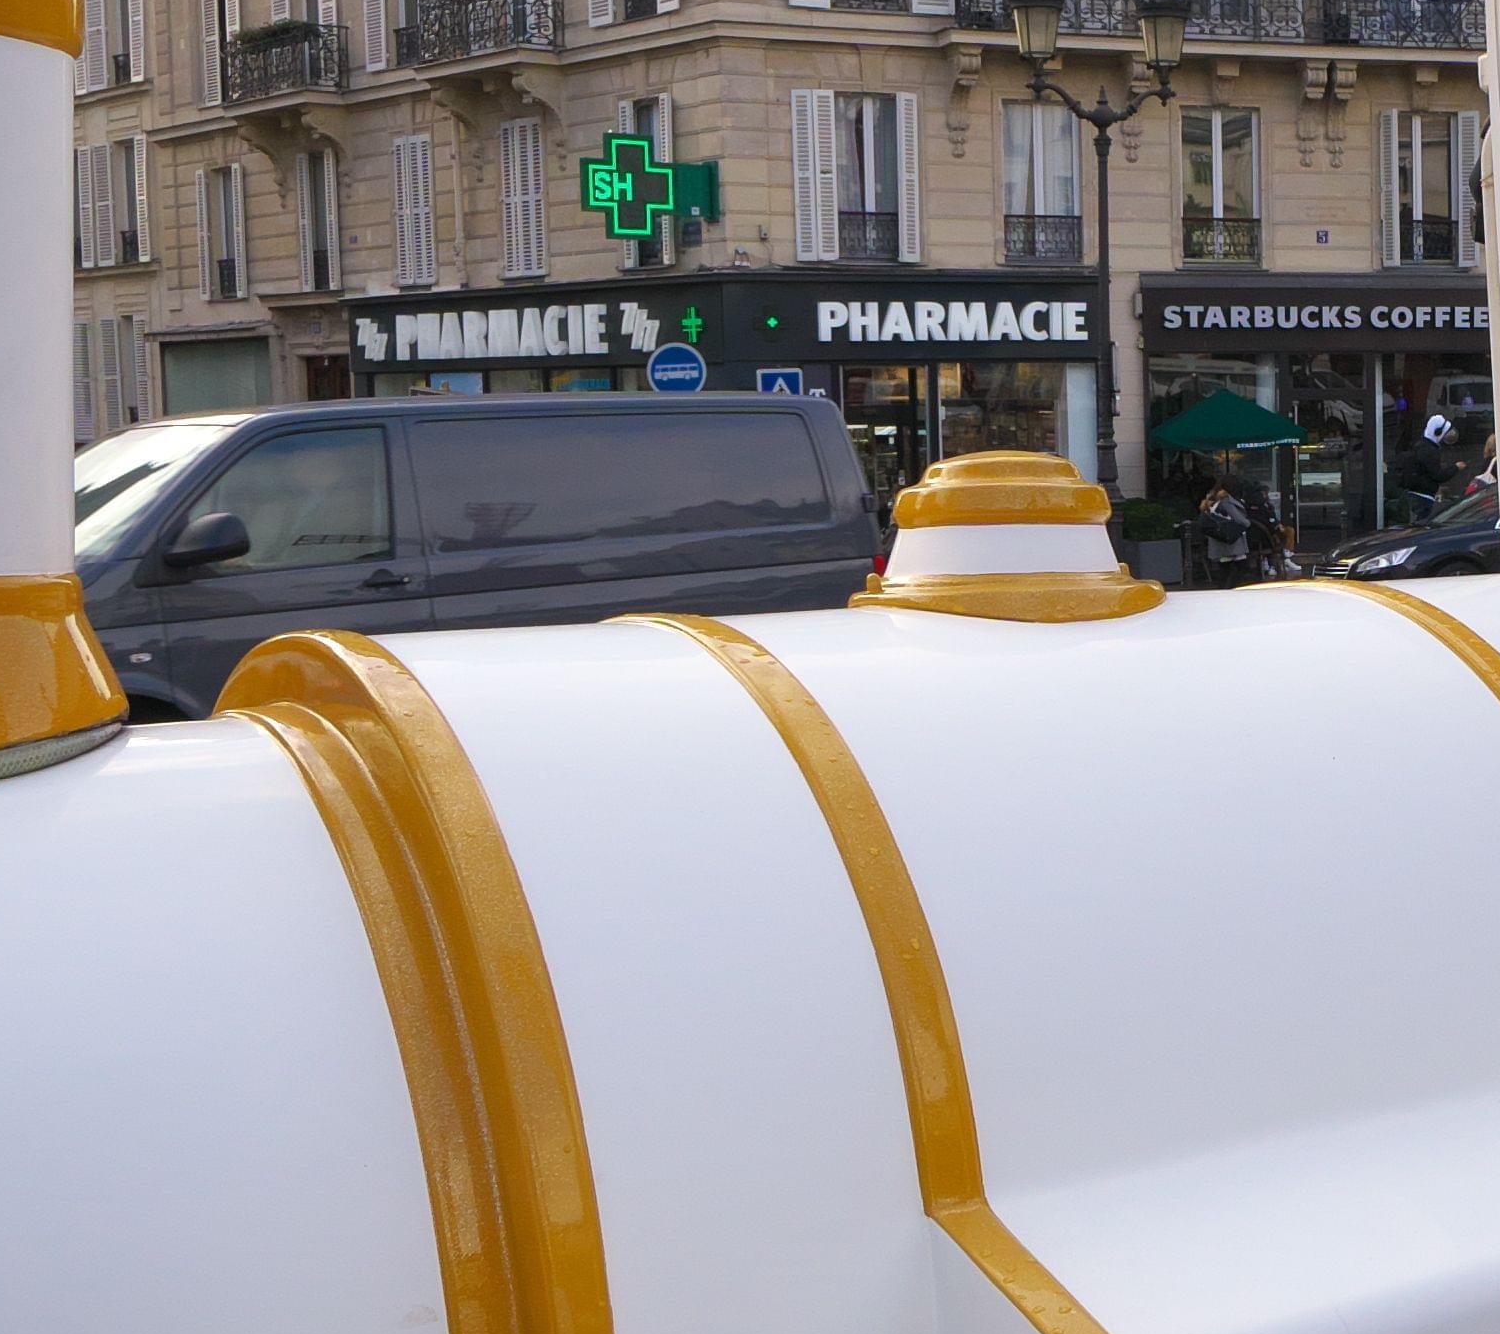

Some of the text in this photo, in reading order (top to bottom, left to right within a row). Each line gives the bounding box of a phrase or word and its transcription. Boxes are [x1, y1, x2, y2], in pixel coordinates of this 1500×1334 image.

[594, 171, 633, 201] SH
[395, 303, 610, 362] PHARMACIE
[816, 301, 1089, 342] PHARMACIE
[1163, 304, 1490, 330] STARBUCKS COFFEE
